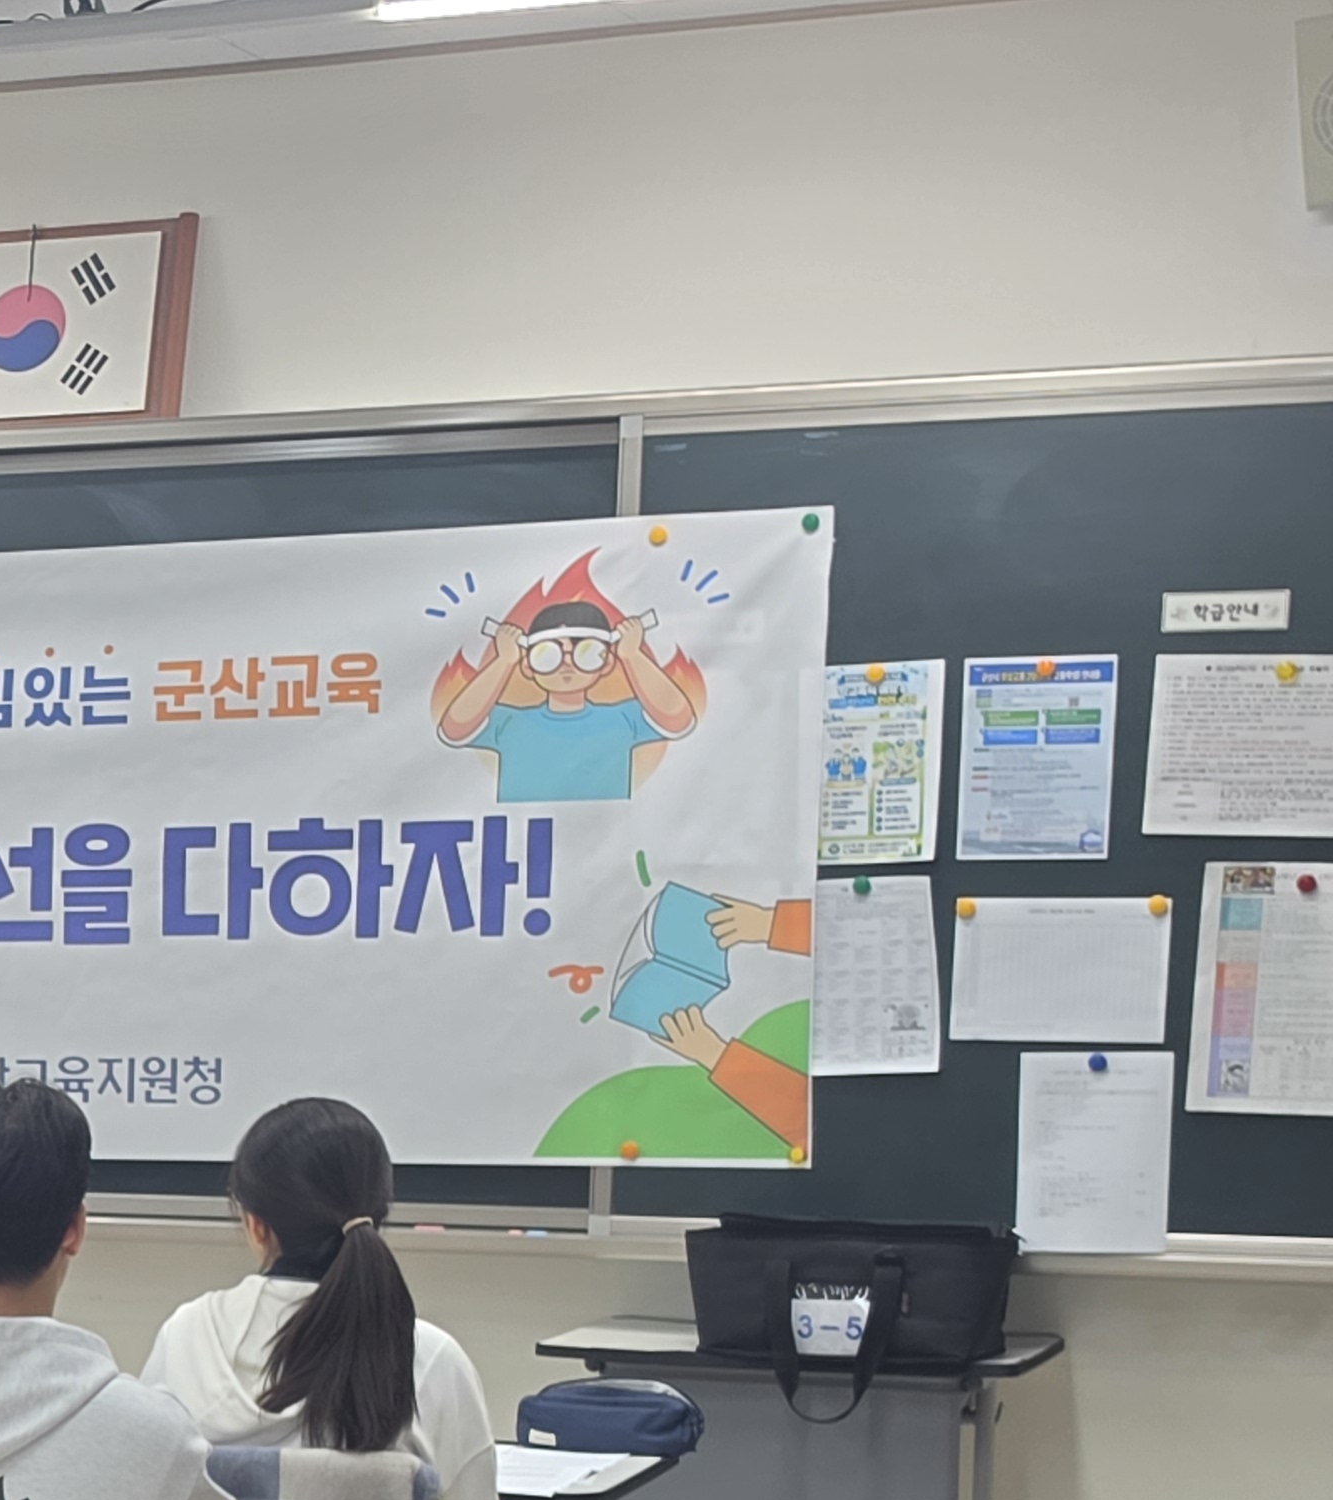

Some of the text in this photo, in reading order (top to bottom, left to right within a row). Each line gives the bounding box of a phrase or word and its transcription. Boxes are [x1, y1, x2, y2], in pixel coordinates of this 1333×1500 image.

[1193, 602, 1259, 622] 학급안내
[152, 652, 383, 722] 군산교육
[161, 815, 554, 940] 다하자!
